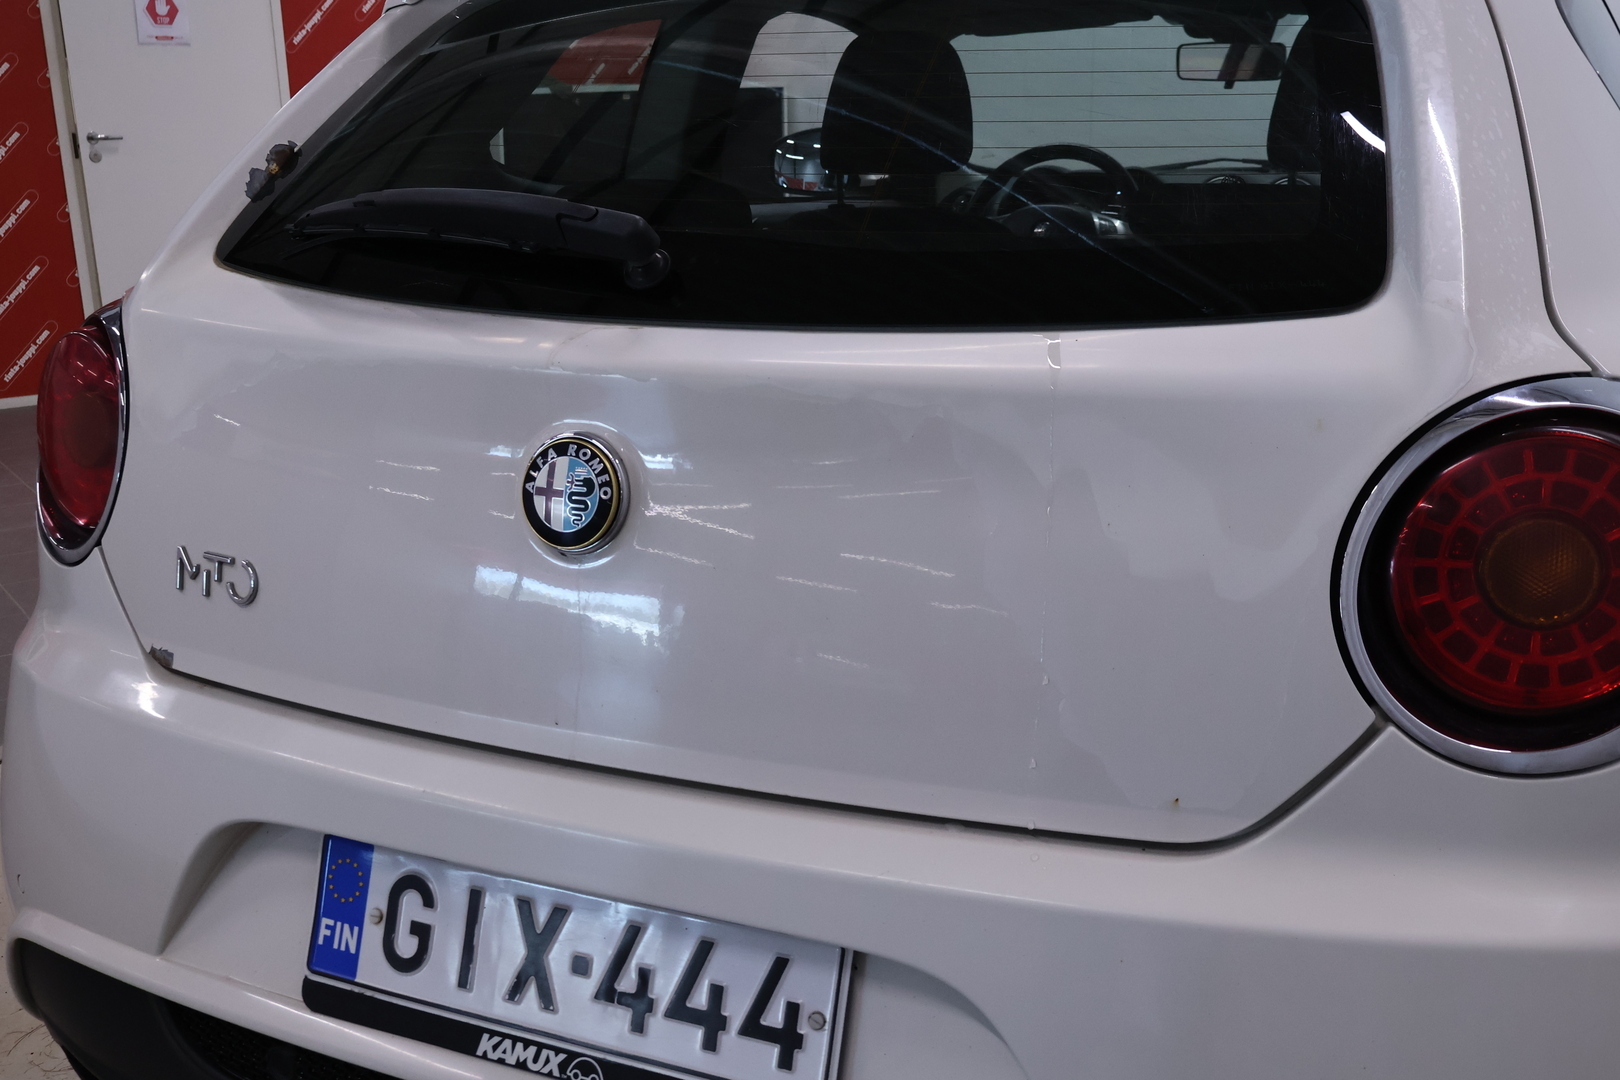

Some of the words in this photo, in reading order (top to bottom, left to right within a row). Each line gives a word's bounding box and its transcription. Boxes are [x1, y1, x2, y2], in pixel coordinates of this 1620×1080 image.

[156, 16, 170, 24] STOP
[3, 329, 50, 383] rinta-jouppi.com
[525, 447, 557, 493] ALFA
[567, 444, 612, 500] ROMEO
[318, 917, 359, 955] FIN
[381, 872, 804, 1073] GIX-444
[475, 1032, 567, 1078] KAMUX
